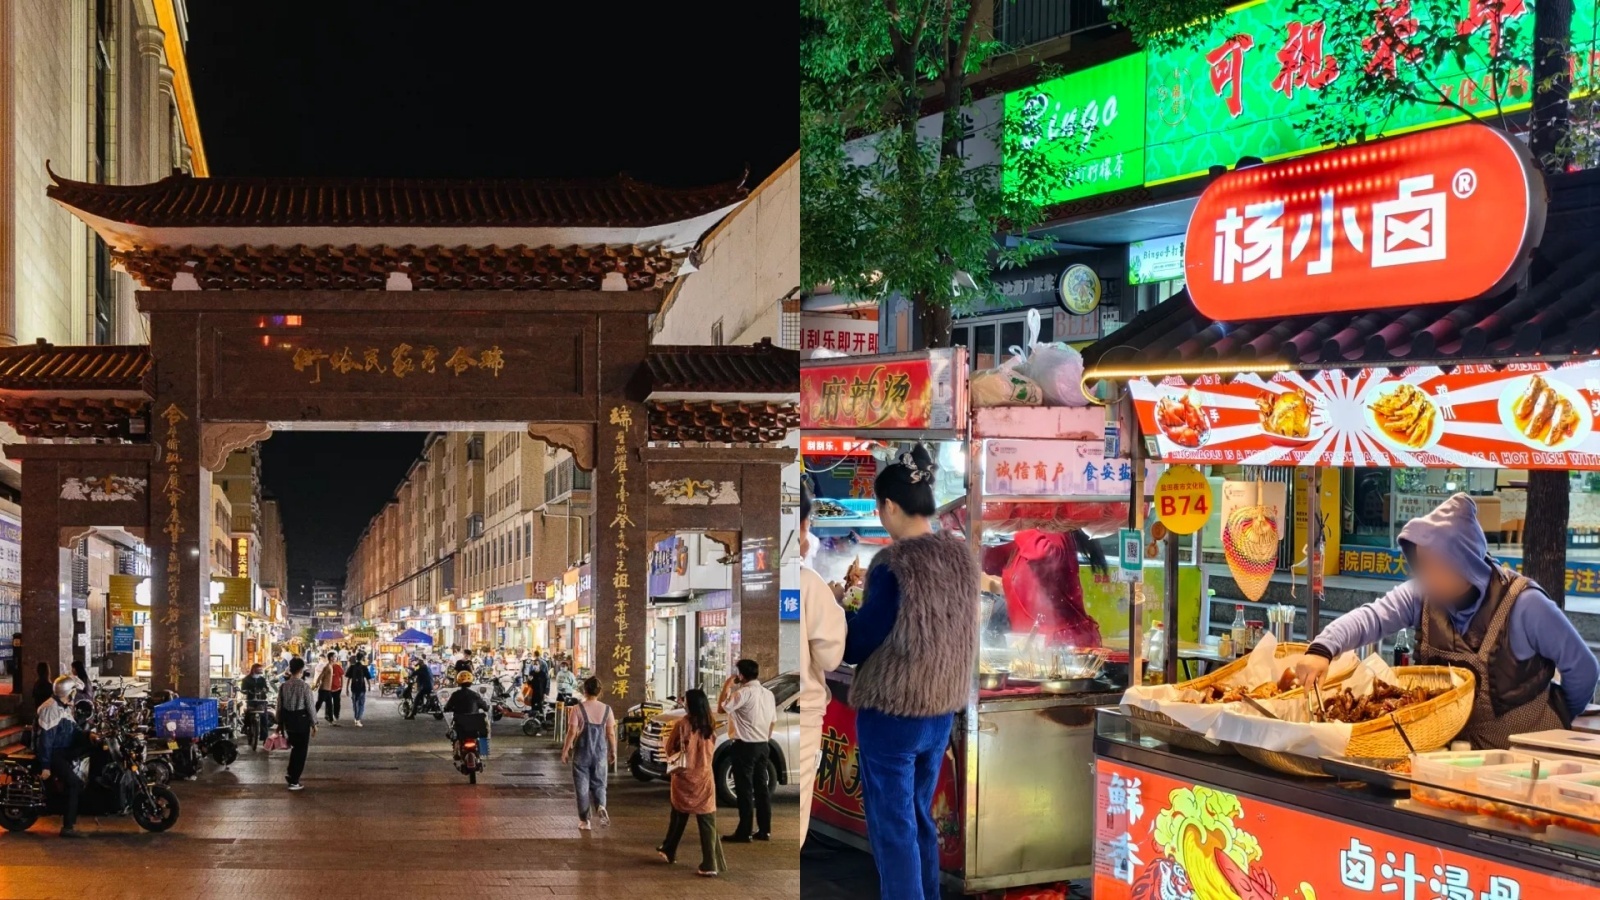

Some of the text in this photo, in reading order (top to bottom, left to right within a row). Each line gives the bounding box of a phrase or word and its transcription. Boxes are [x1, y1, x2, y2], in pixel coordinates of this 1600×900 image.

[1021, 92, 1118, 153] Bingo
[1213, 174, 1447, 284] 杨小卤
[815, 366, 911, 429] 麻辣烫
[1244, 449, 1263, 461] HO
[1501, 452, 1528, 464] HOT
[1531, 452, 1567, 465] DISH
[1083, 461, 1149, 481] 食安盐
[1161, 495, 1208, 516] B74
[780, 597, 798, 612] 修
